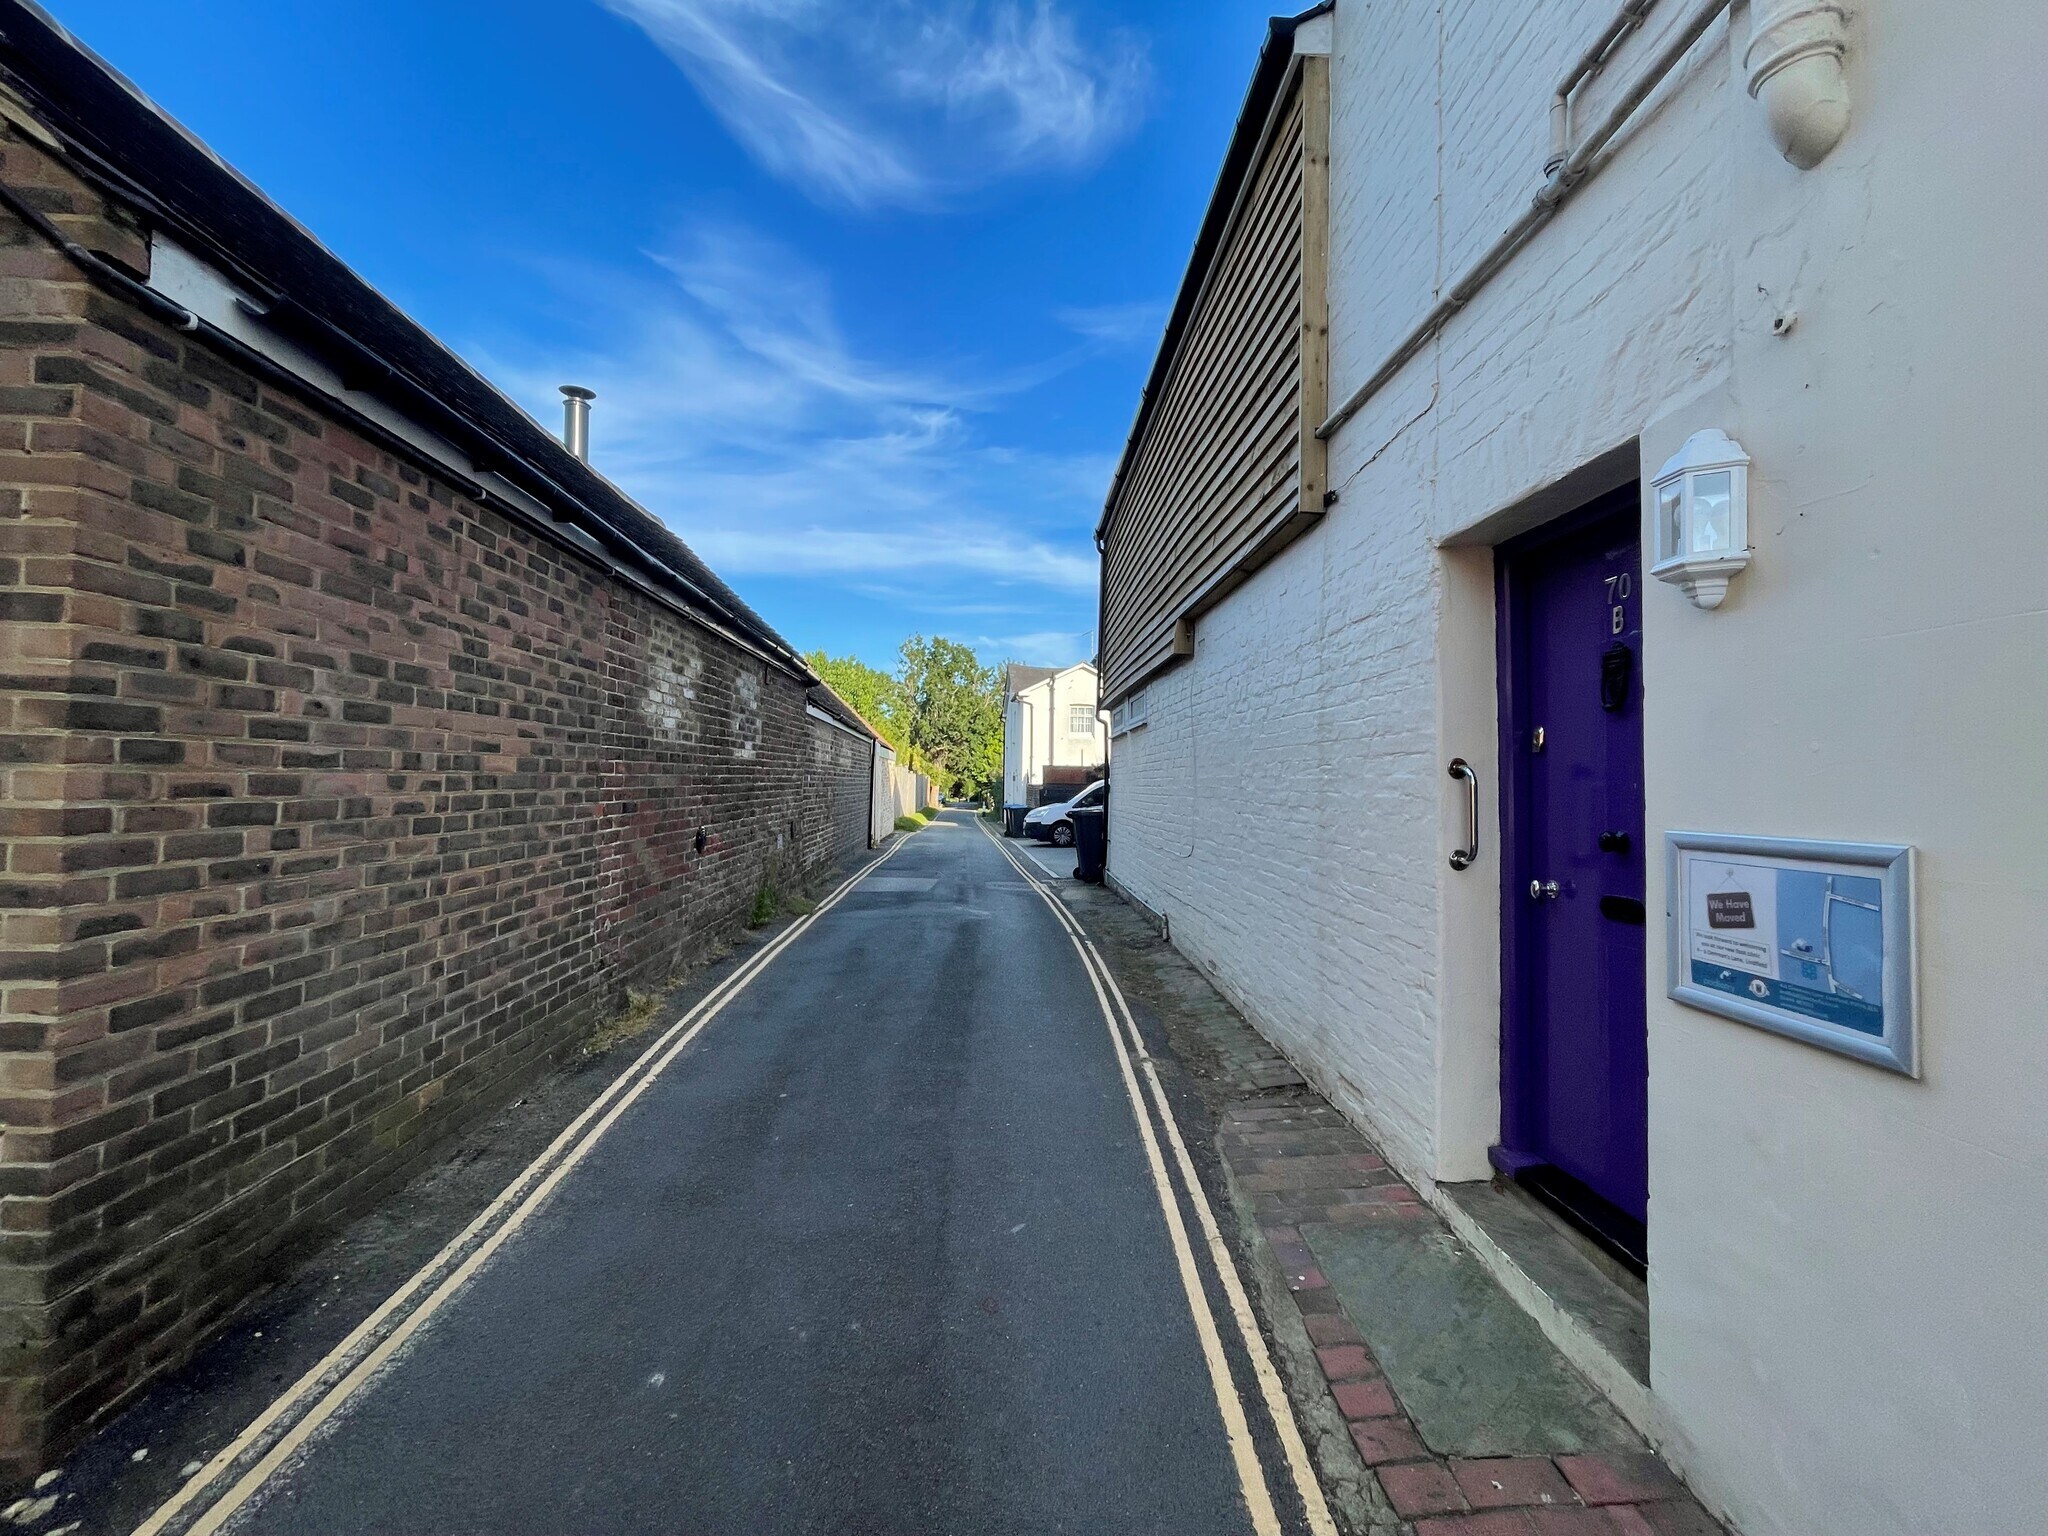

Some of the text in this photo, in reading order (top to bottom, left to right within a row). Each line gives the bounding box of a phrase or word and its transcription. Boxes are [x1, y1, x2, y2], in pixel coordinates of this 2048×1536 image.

[1604, 572, 1632, 604] 70
[1612, 605, 1624, 634] B
[1709, 898, 1750, 909] We Have
[1715, 911, 1746, 922] Moved
